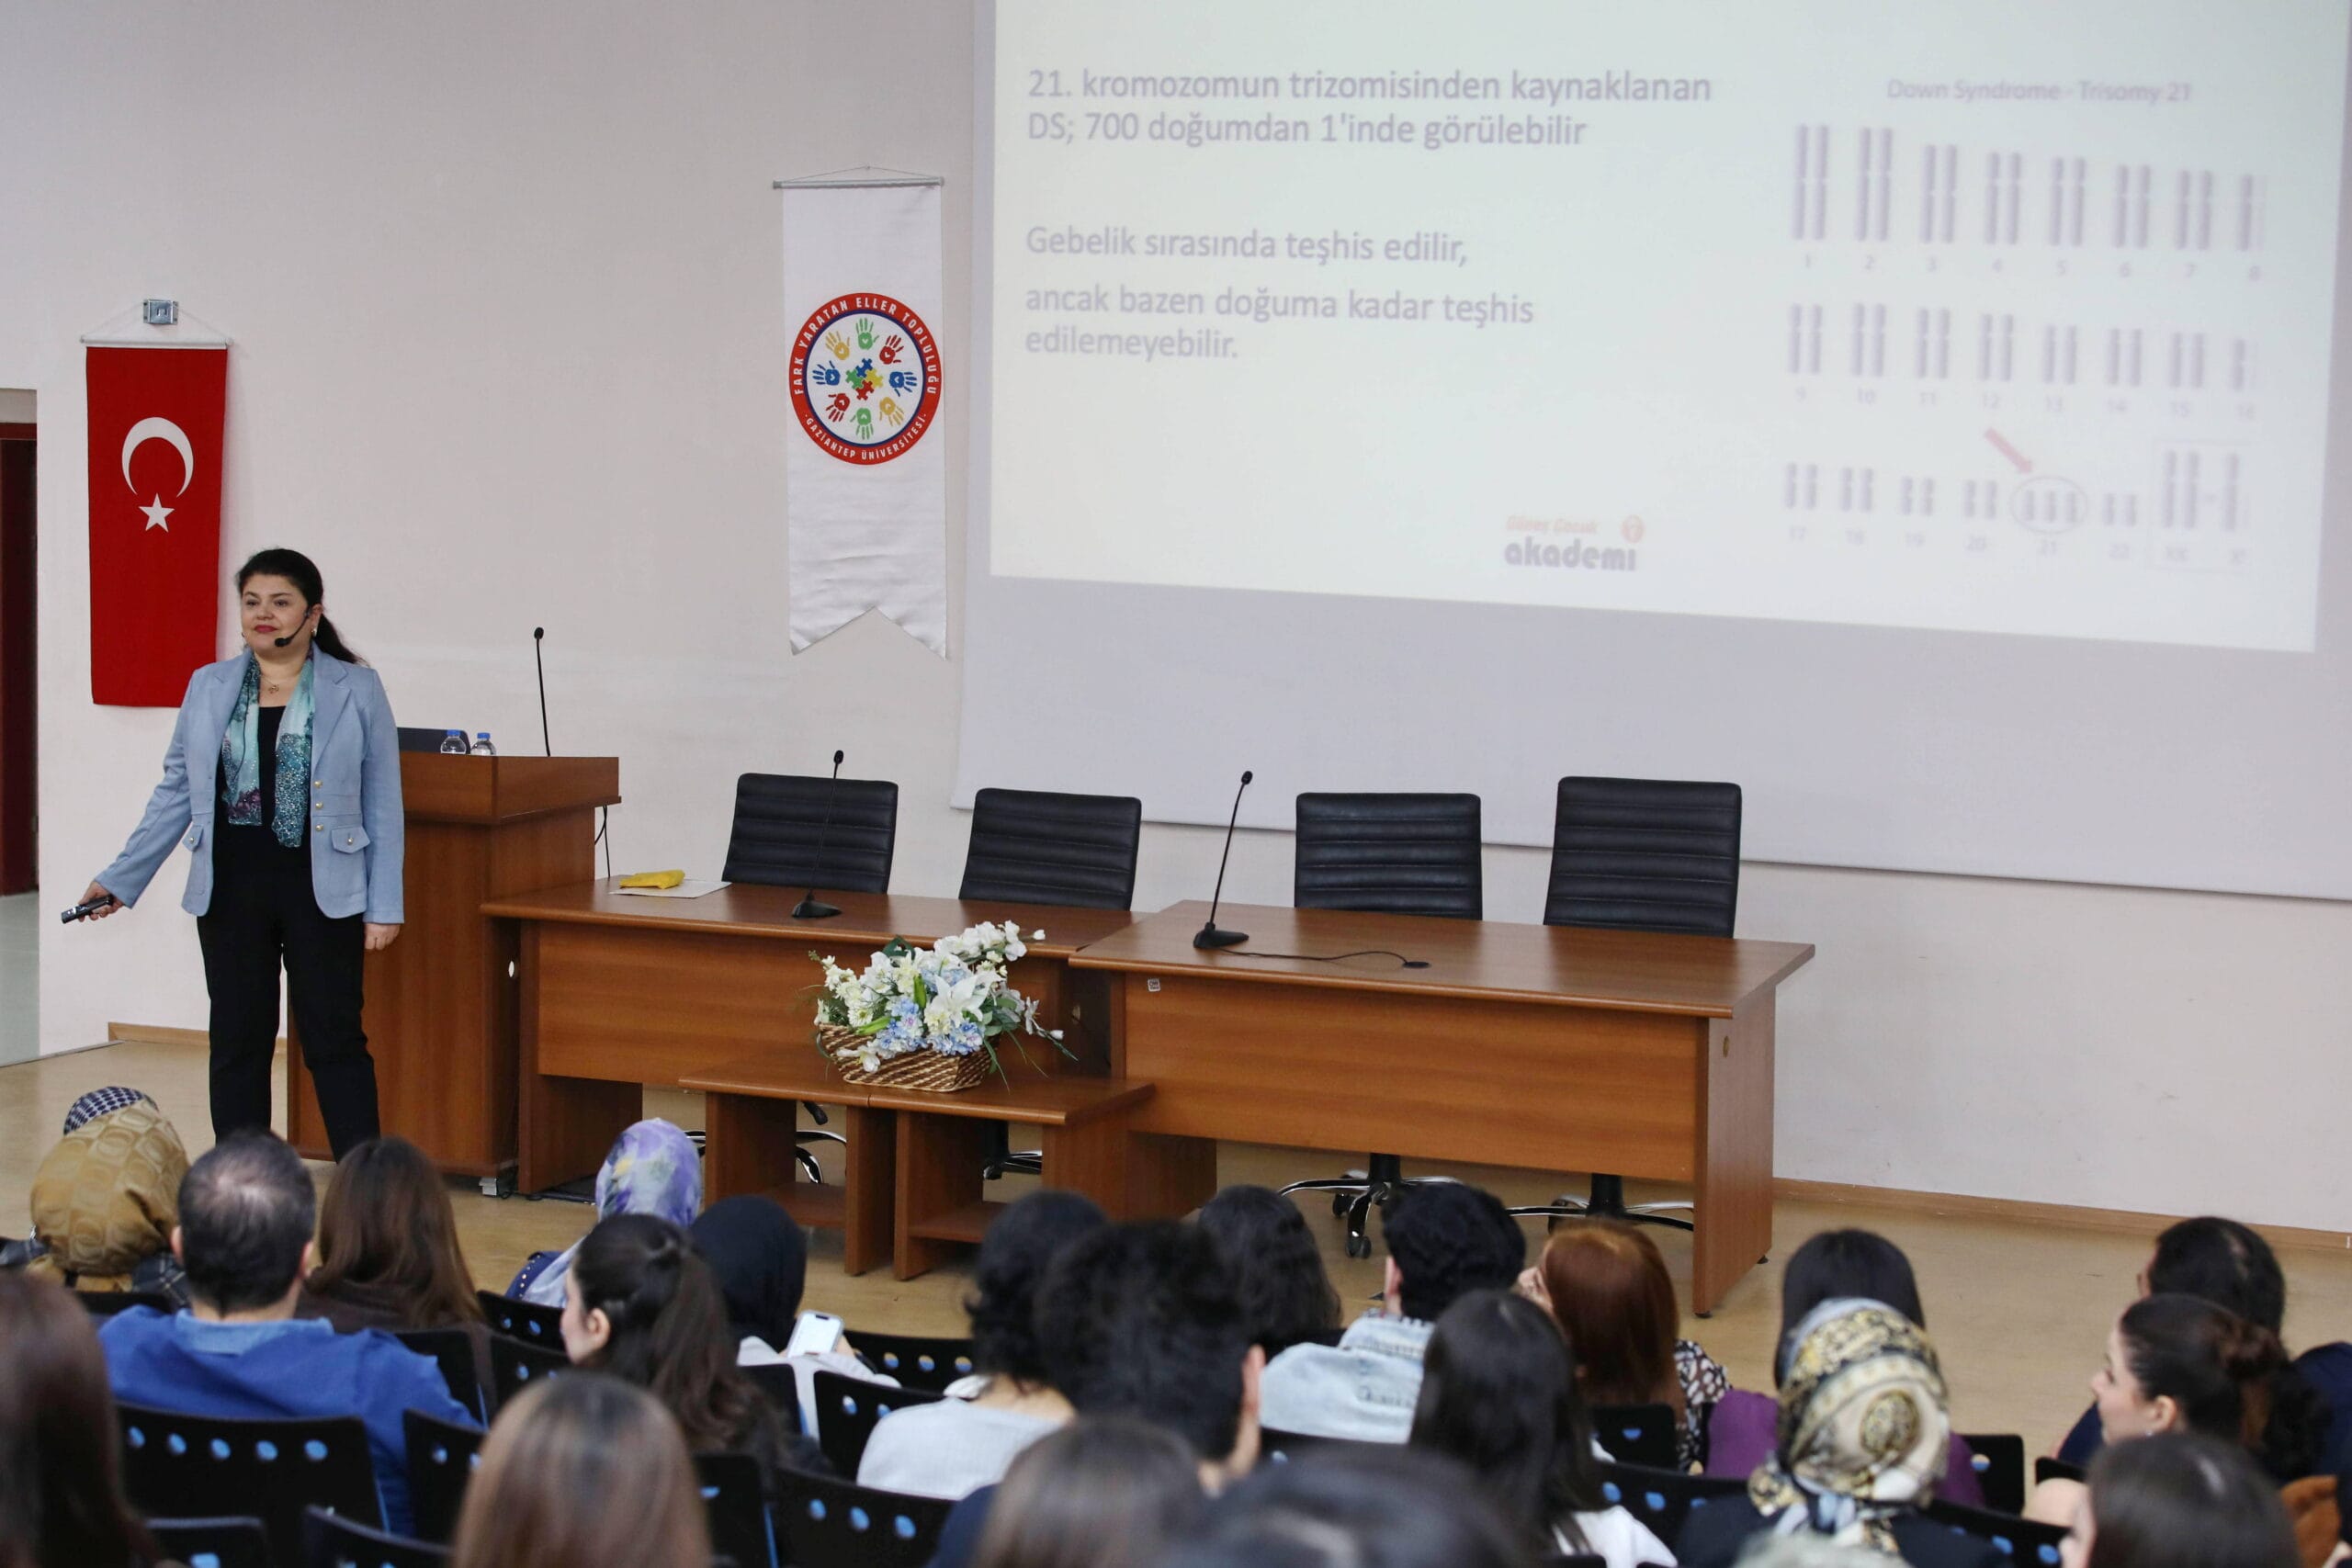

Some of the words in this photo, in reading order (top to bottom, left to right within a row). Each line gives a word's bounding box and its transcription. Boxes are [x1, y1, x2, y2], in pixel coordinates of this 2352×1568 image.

[1029, 69, 1072, 97] 21.
[1082, 68, 1280, 99] kromozomun
[1289, 69, 1501, 100] trizomisinden
[1511, 69, 1713, 107] kaynaklanan
[1886, 78, 1948, 99] Down
[1954, 79, 2061, 104] Syndrome
[1028, 112, 1074, 145] DS;
[1085, 112, 1139, 141] 700
[1148, 111, 1311, 149] doğumdan
[1320, 112, 1415, 144] 1'inde
[1423, 113, 1589, 152] görülebilir
[1026, 225, 1136, 256] Gebelik
[1144, 228, 1277, 260] sırasında
[1284, 230, 1374, 266] teşhis
[1384, 231, 1468, 267] edilir,
[798, 299, 849, 349] YARATAN
[855, 297, 897, 315] ELLER
[1025, 284, 1109, 313] ancak
[1119, 286, 1205, 316] bazen
[1215, 287, 1339, 323] doğuma
[1348, 288, 1433, 321] kadar
[1442, 292, 1535, 329] teşhis
[902, 313, 939, 394] TOPLULUĞU
[1025, 328, 1238, 363] edilemeyebilir.
[793, 357, 805, 395] FARK
[806, 416, 856, 458] GAZİANTEP
[861, 416, 927, 460] ÜNİVERSİTESİ
[1503, 535, 1637, 572] akademi
